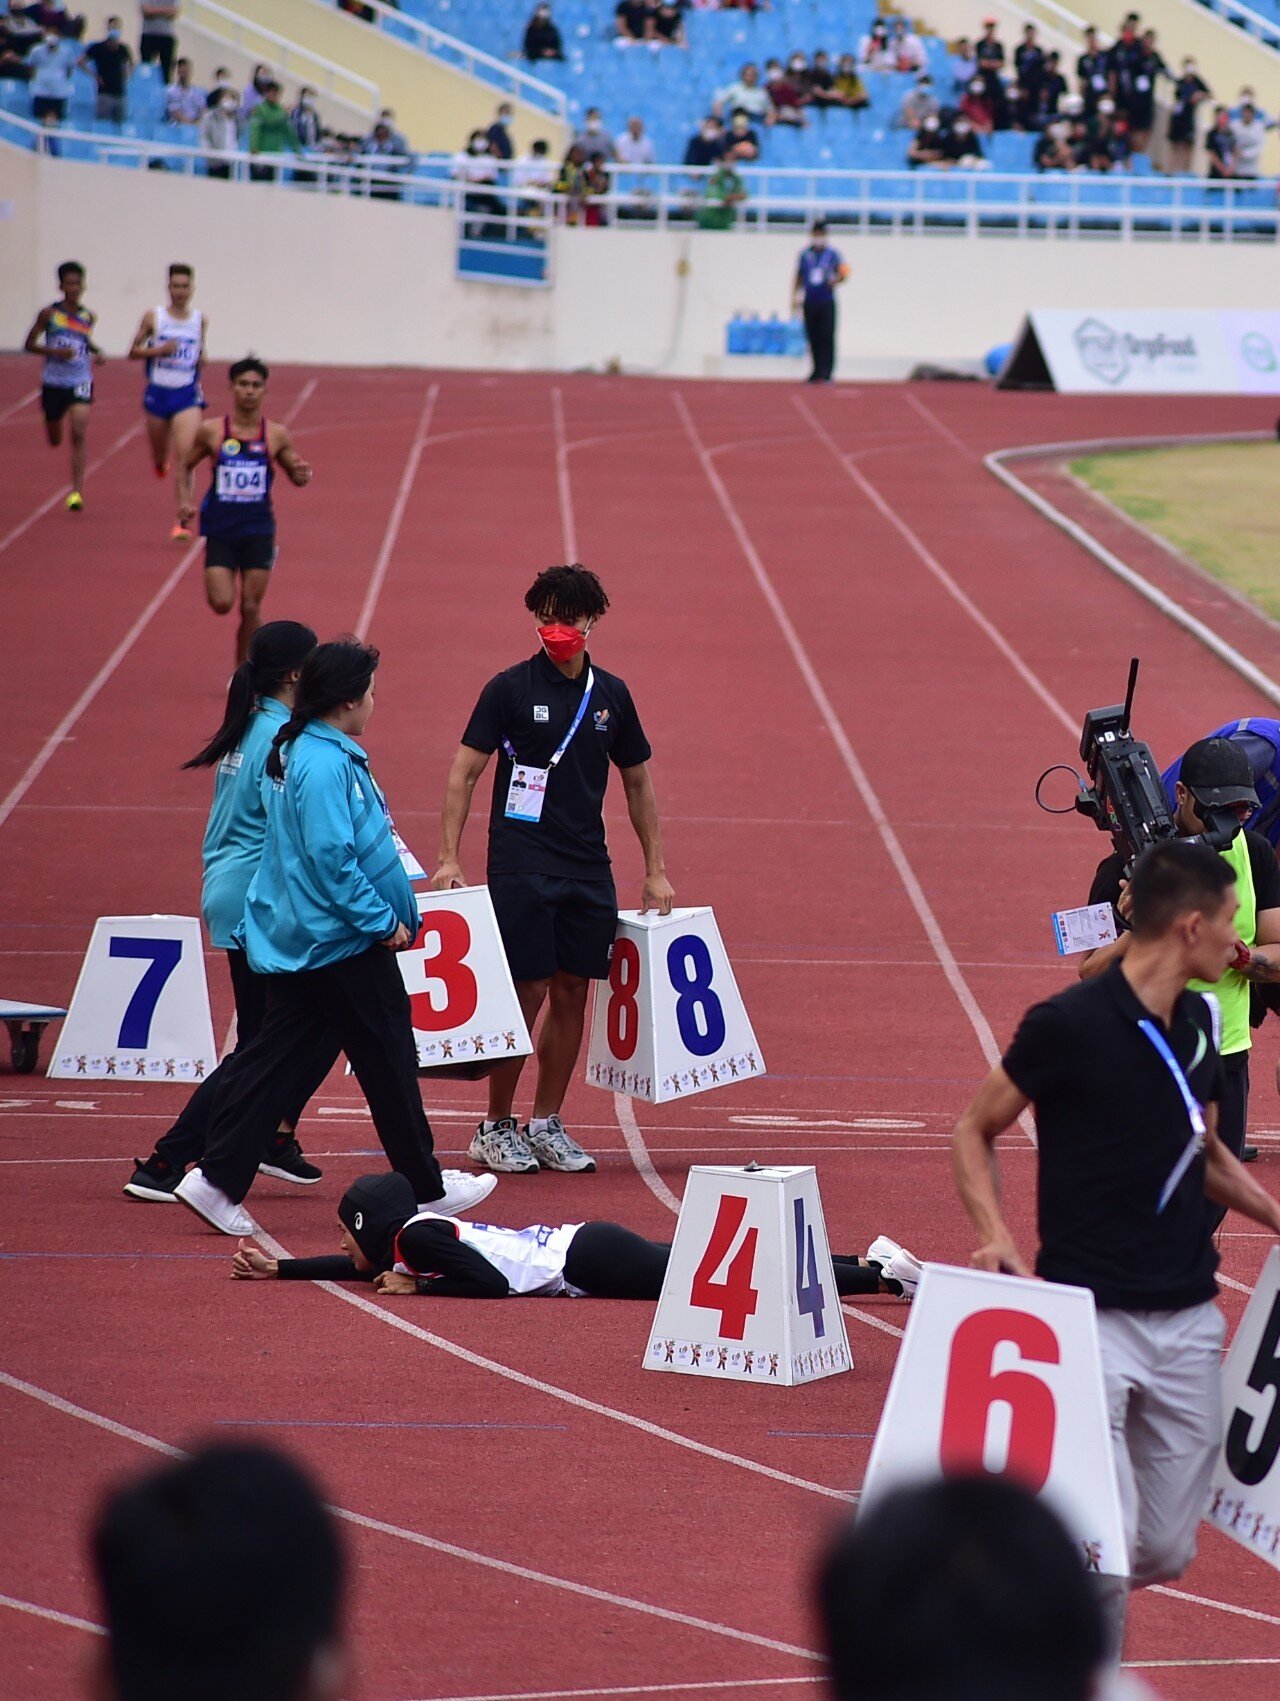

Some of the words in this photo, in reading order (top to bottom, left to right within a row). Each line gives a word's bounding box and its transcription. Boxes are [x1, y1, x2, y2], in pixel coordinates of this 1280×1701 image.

[224, 471, 260, 489] 104
[109, 936, 183, 1049] 7
[408, 909, 478, 1032] 3
[607, 937, 640, 1061] 8
[666, 934, 726, 1057] 8
[689, 1194, 760, 1342] 4
[793, 1196, 825, 1339] 4
[939, 1307, 1060, 1496] 6
